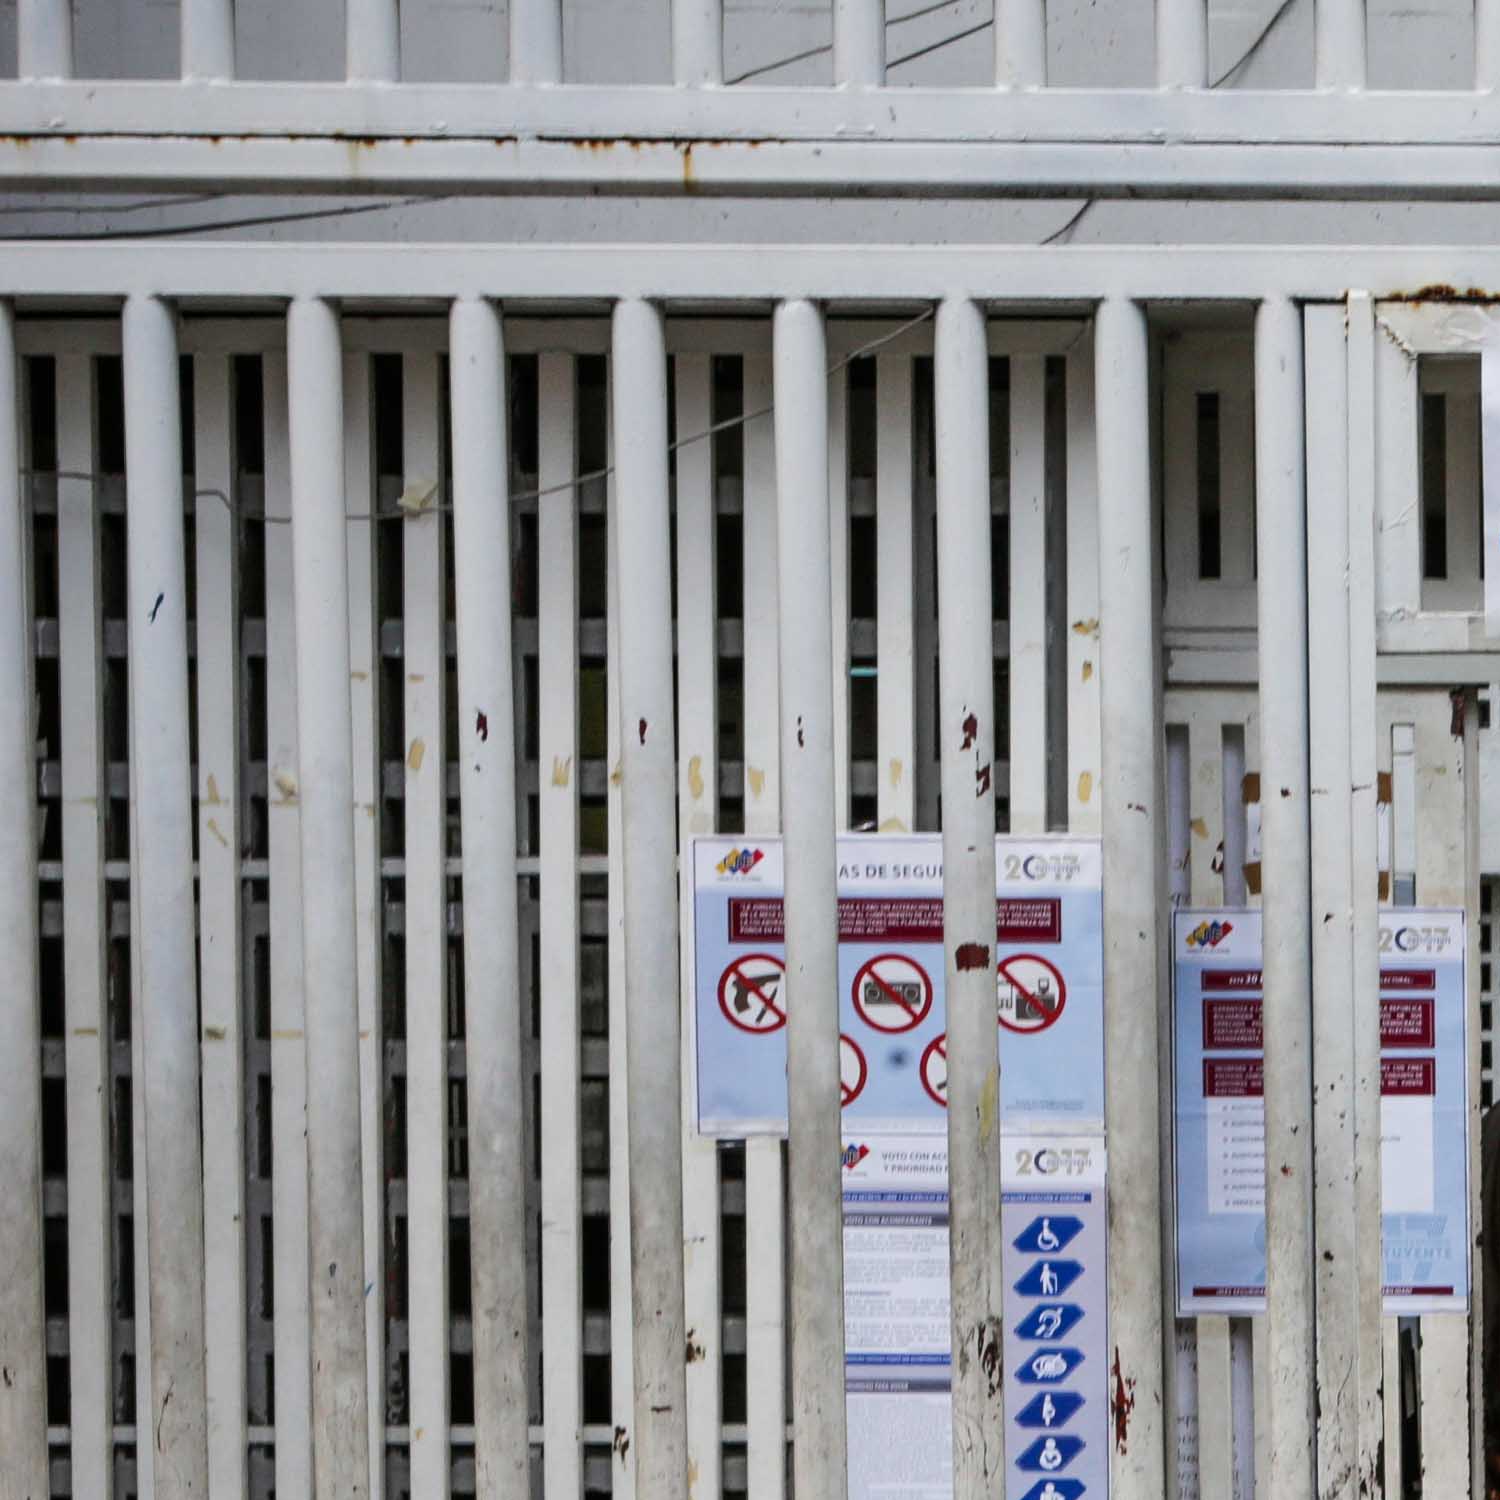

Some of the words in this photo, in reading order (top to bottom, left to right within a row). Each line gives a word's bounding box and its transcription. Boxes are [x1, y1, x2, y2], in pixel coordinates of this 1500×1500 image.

[839, 865, 861, 878] AS
[865, 865, 888, 878] DE
[892, 865, 944, 878] SEGU
